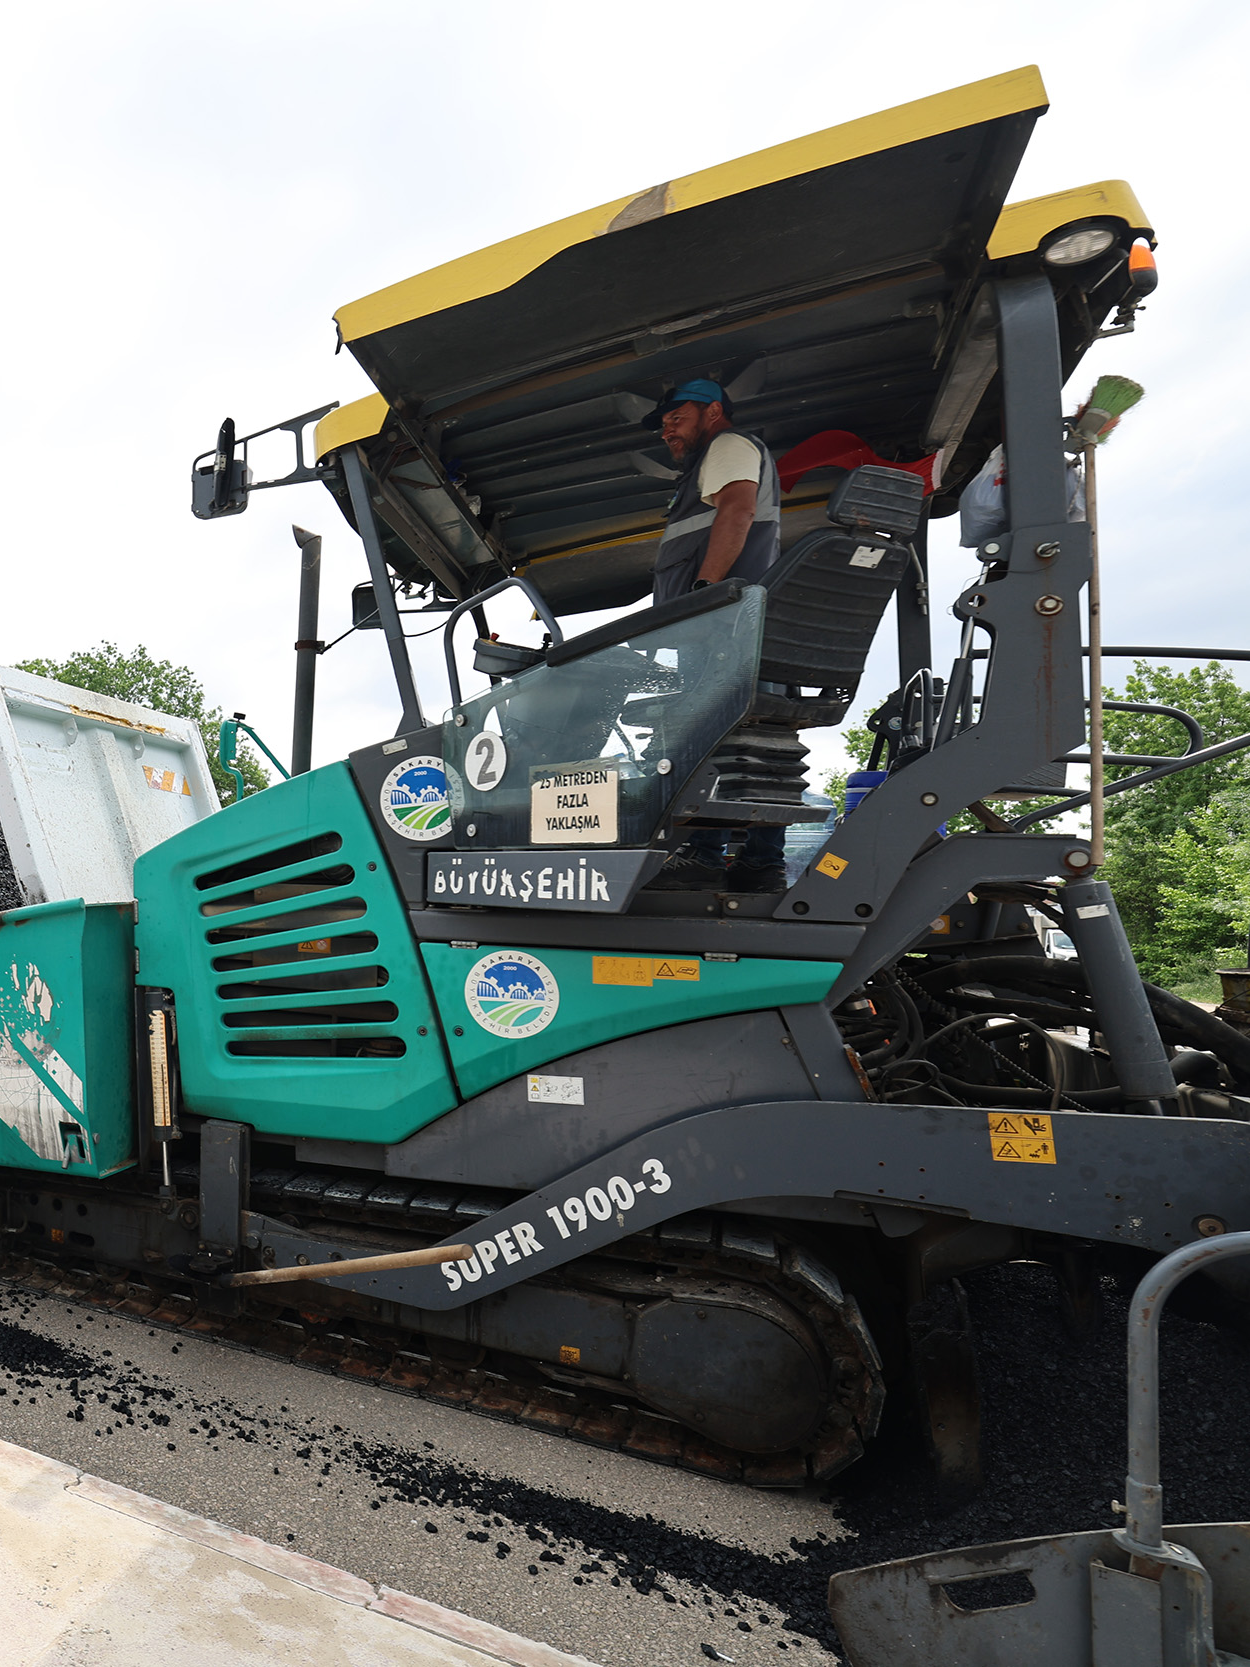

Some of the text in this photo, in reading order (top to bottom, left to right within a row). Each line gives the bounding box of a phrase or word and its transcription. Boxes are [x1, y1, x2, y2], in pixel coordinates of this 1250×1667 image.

[393, 760, 442, 777] SAKARY
[475, 738, 496, 785] 2
[539, 770, 608, 789] 25 METREDEN
[556, 793, 589, 809] FAZLA
[545, 815, 601, 833] YAKLAŞMA
[434, 858, 611, 902] BÜYÜKŞEHİR
[481, 955, 541, 972] SAKARYA
[440, 1158, 672, 1292] SUPER 1900-3
